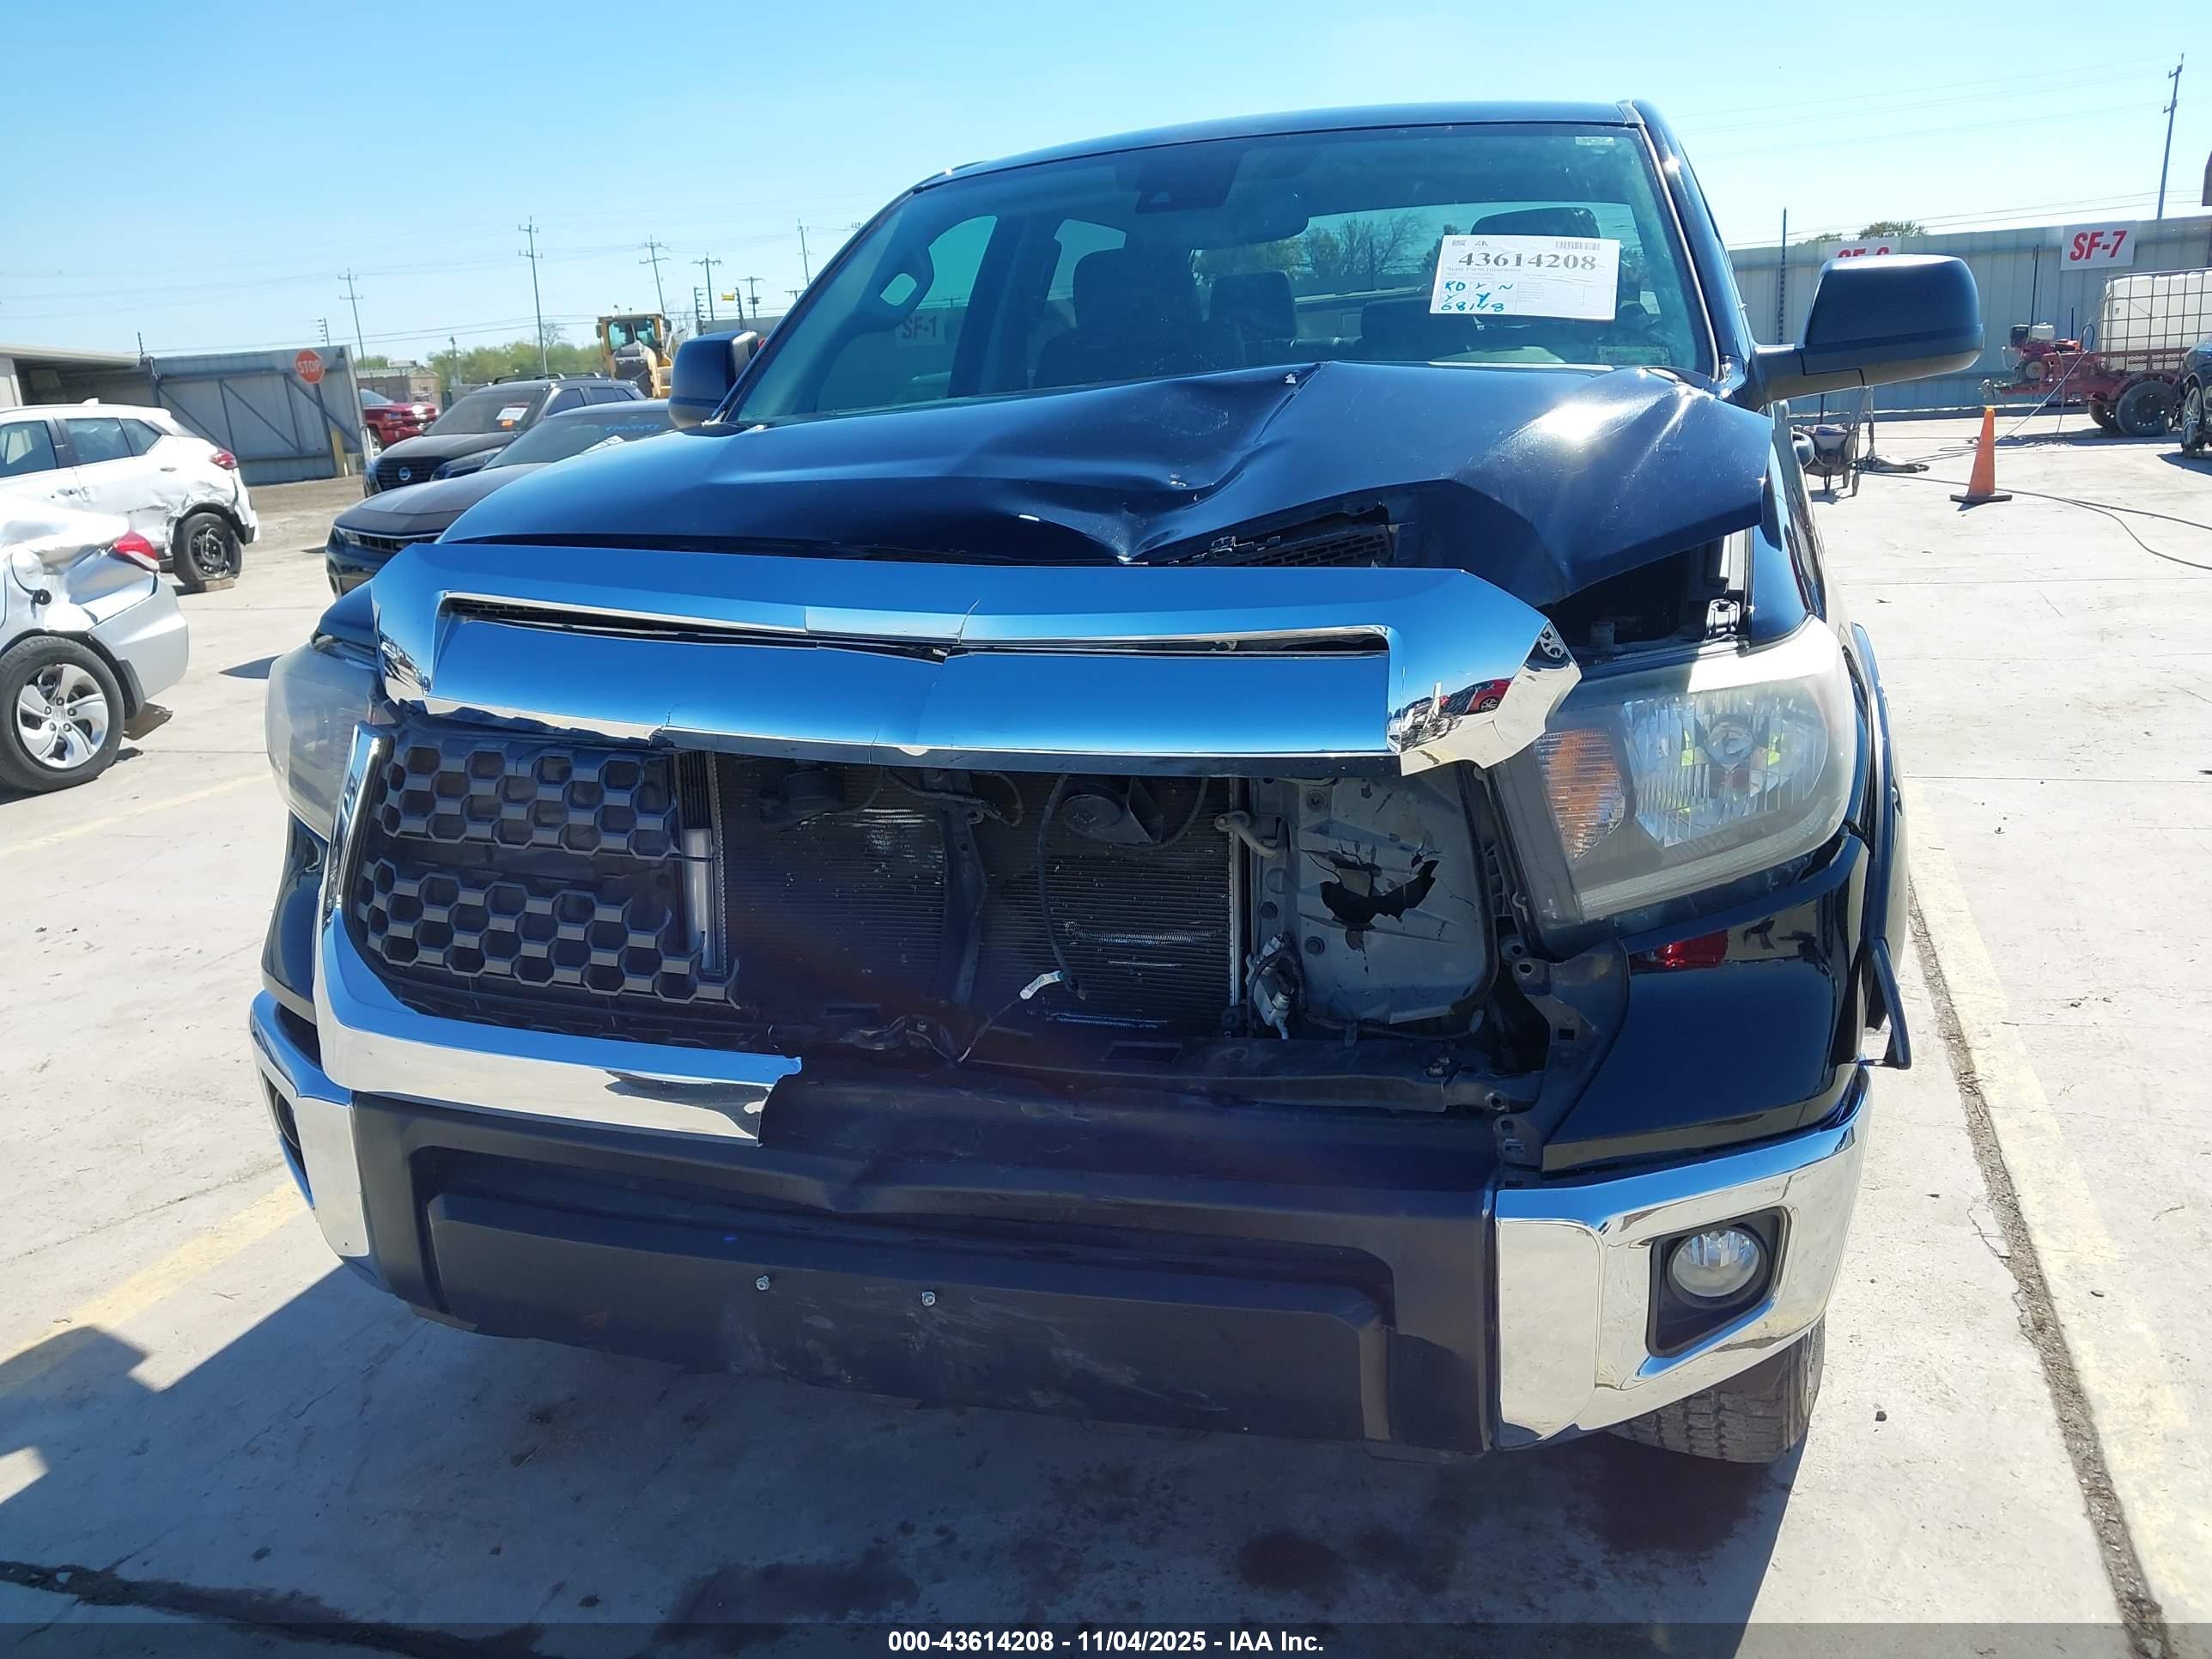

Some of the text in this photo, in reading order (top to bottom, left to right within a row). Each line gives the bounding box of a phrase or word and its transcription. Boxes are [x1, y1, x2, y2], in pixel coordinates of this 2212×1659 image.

[2069, 229, 2128, 261] SF-7
[1458, 252, 1596, 270] 43614208
[902, 315, 937, 339] SF-1
[297, 359, 321, 374] STOP
